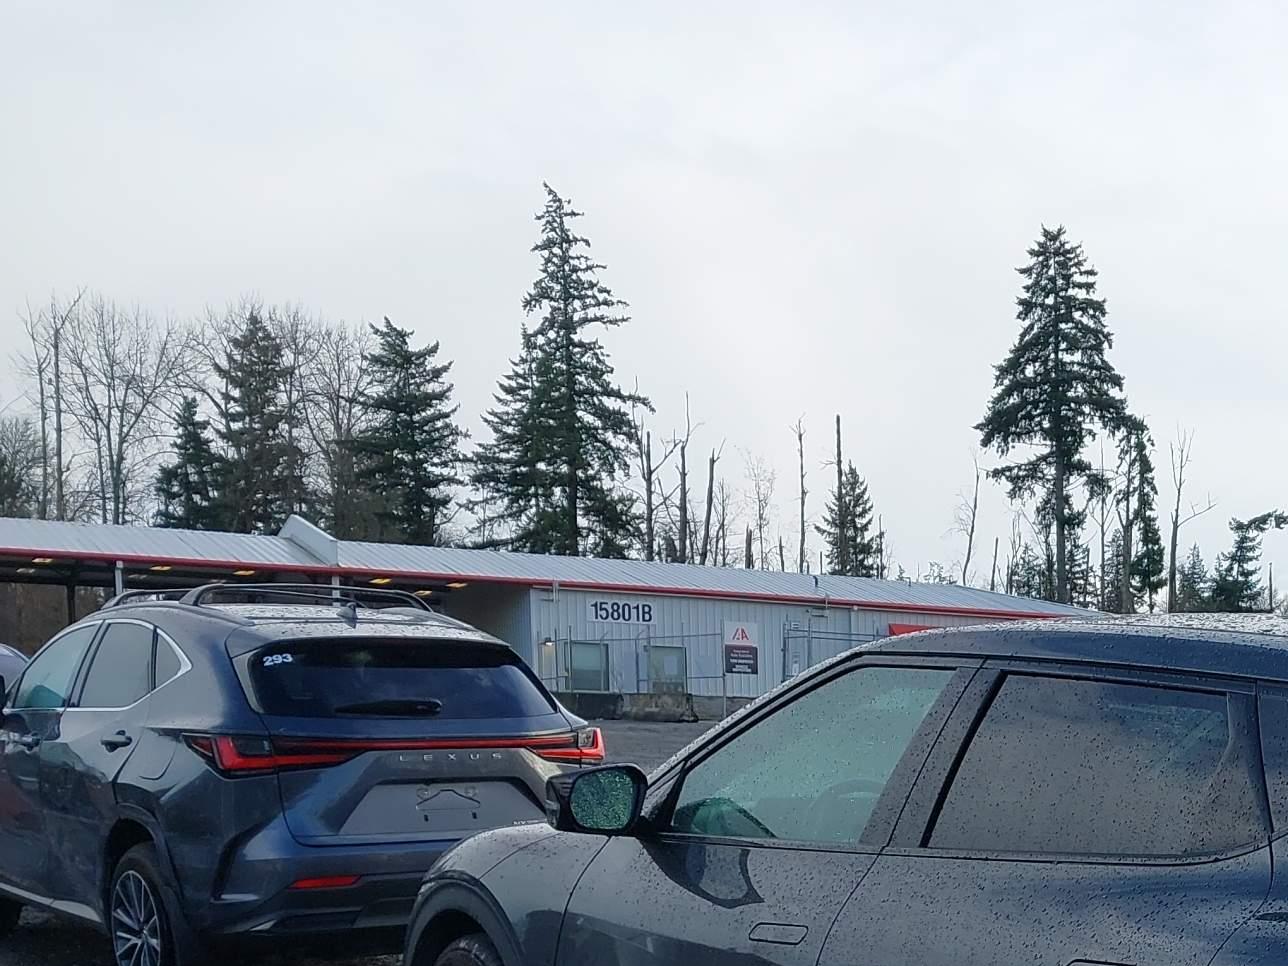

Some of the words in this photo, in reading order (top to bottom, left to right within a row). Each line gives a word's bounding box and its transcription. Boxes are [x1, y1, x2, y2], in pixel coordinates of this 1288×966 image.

[590, 601, 653, 623] 15801B
[262, 653, 293, 667] 293
[399, 752, 502, 762] LEXUS
